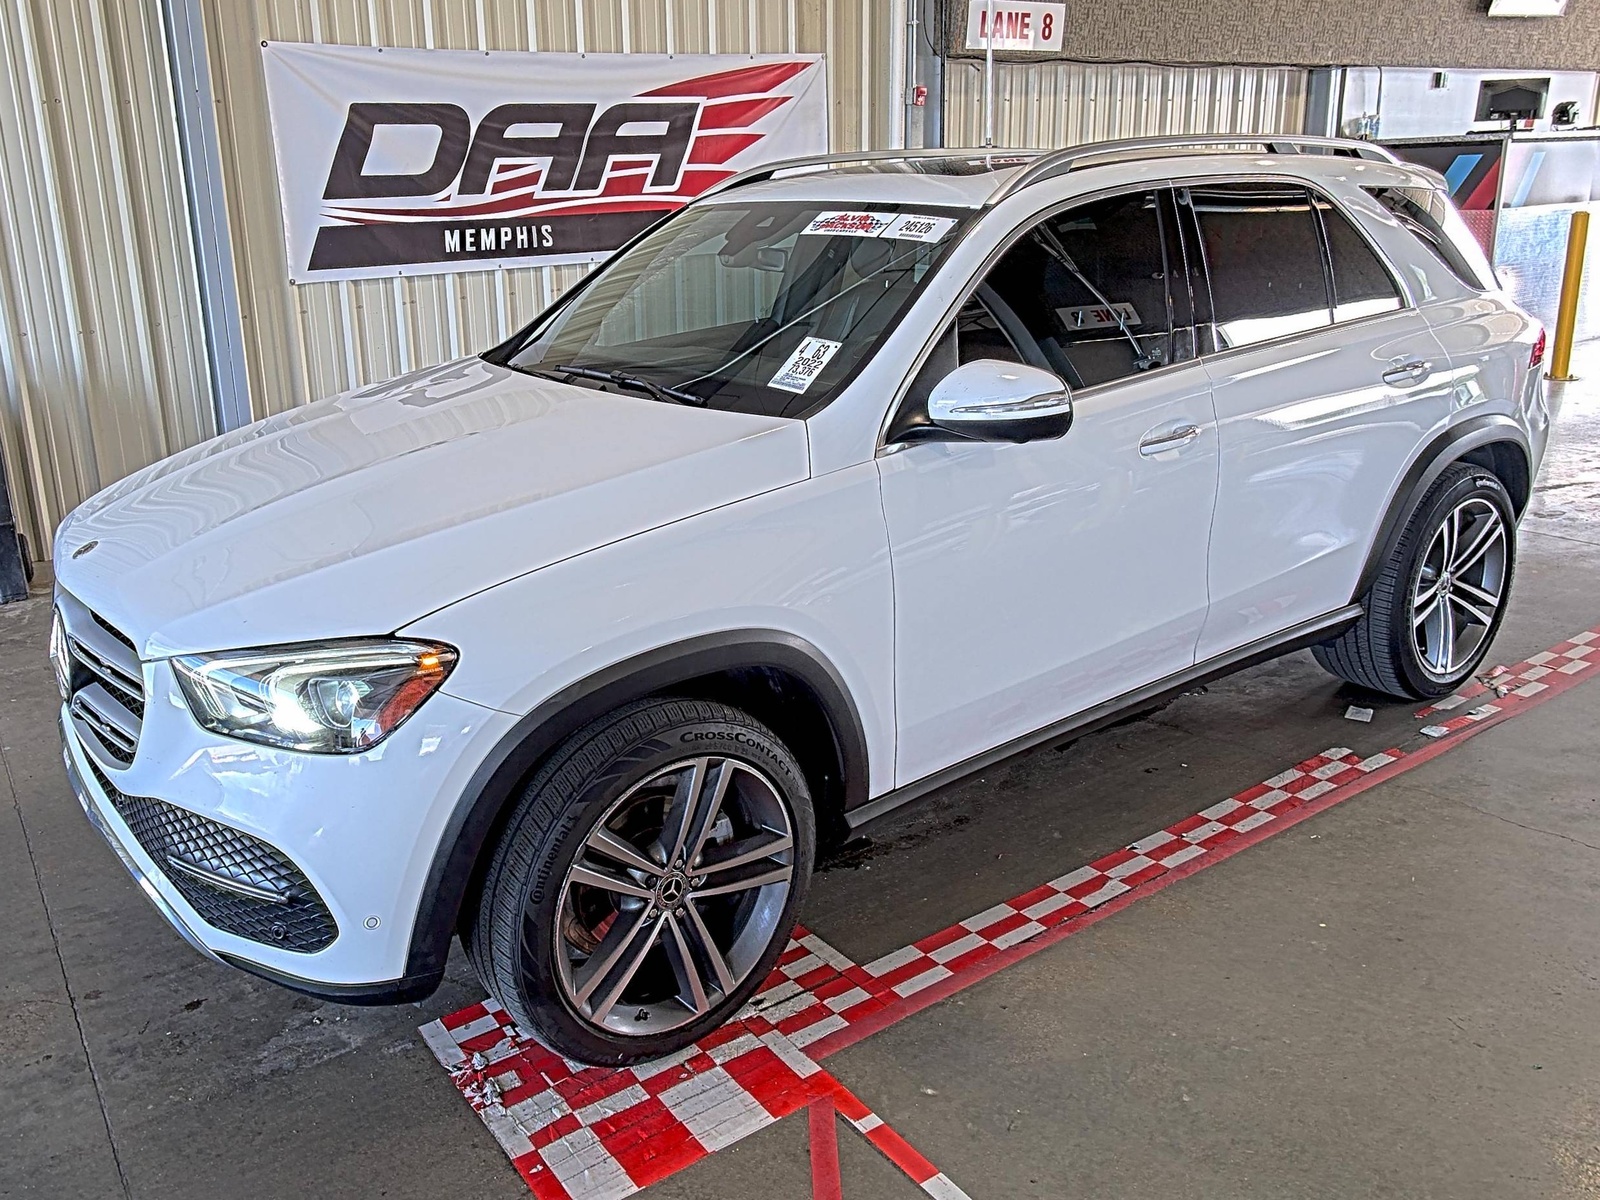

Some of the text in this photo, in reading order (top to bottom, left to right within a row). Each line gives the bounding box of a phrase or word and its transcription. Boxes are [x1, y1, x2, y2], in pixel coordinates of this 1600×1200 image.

[979, 10, 1054, 41] LANE 8
[322, 102, 701, 200] DAA
[444, 224, 554, 253] MEMPHIS
[899, 220, 936, 234] 245126
[798, 341, 831, 360] 4 63
[794, 356, 824, 370] 2022
